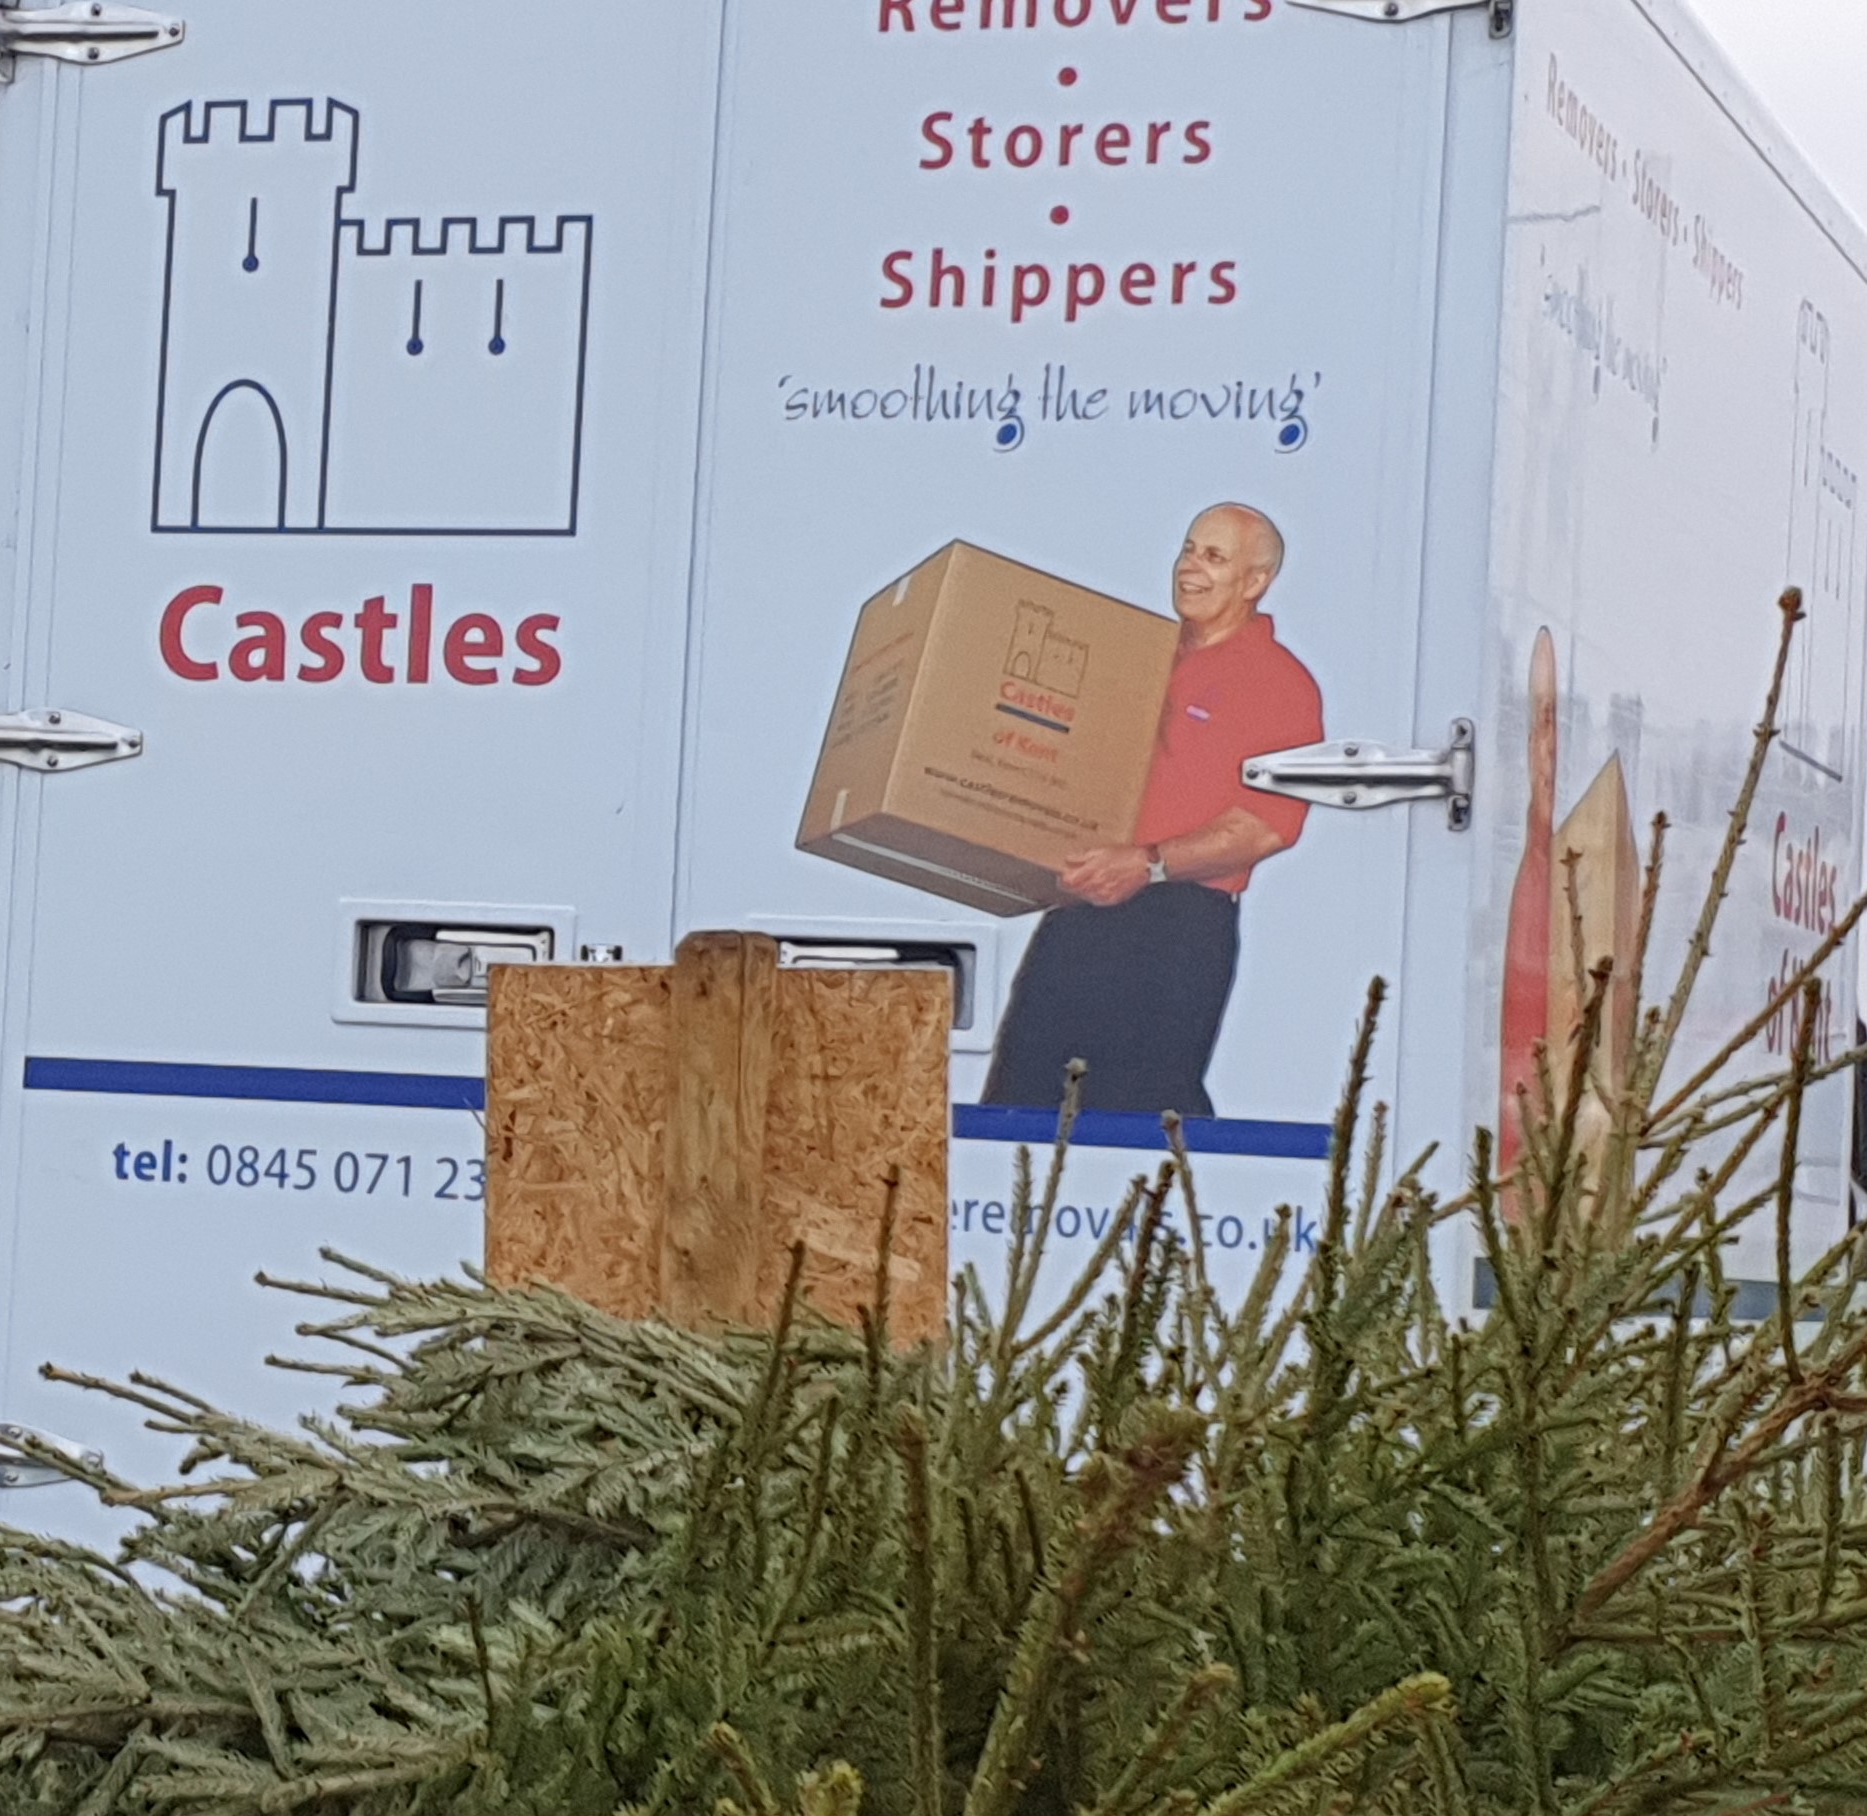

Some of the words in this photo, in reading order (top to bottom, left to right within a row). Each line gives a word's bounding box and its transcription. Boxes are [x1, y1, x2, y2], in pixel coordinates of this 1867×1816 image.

[918, 111, 1212, 170] Storers
[1546, 51, 1618, 182] Removers
[1632, 148, 1680, 247] Storers
[1693, 213, 1744, 311] Shippers
[879, 247, 1238, 323] Shippers
[1038, 363, 1109, 421] the
[159, 583, 562, 687] Castles
[1771, 810, 1838, 937] Castles
[1789, 955, 1833, 1067] Knt
[112, 1139, 189, 1184] tel:
[206, 1143, 318, 1190] 0845
[333, 1151, 413, 1198] 071
